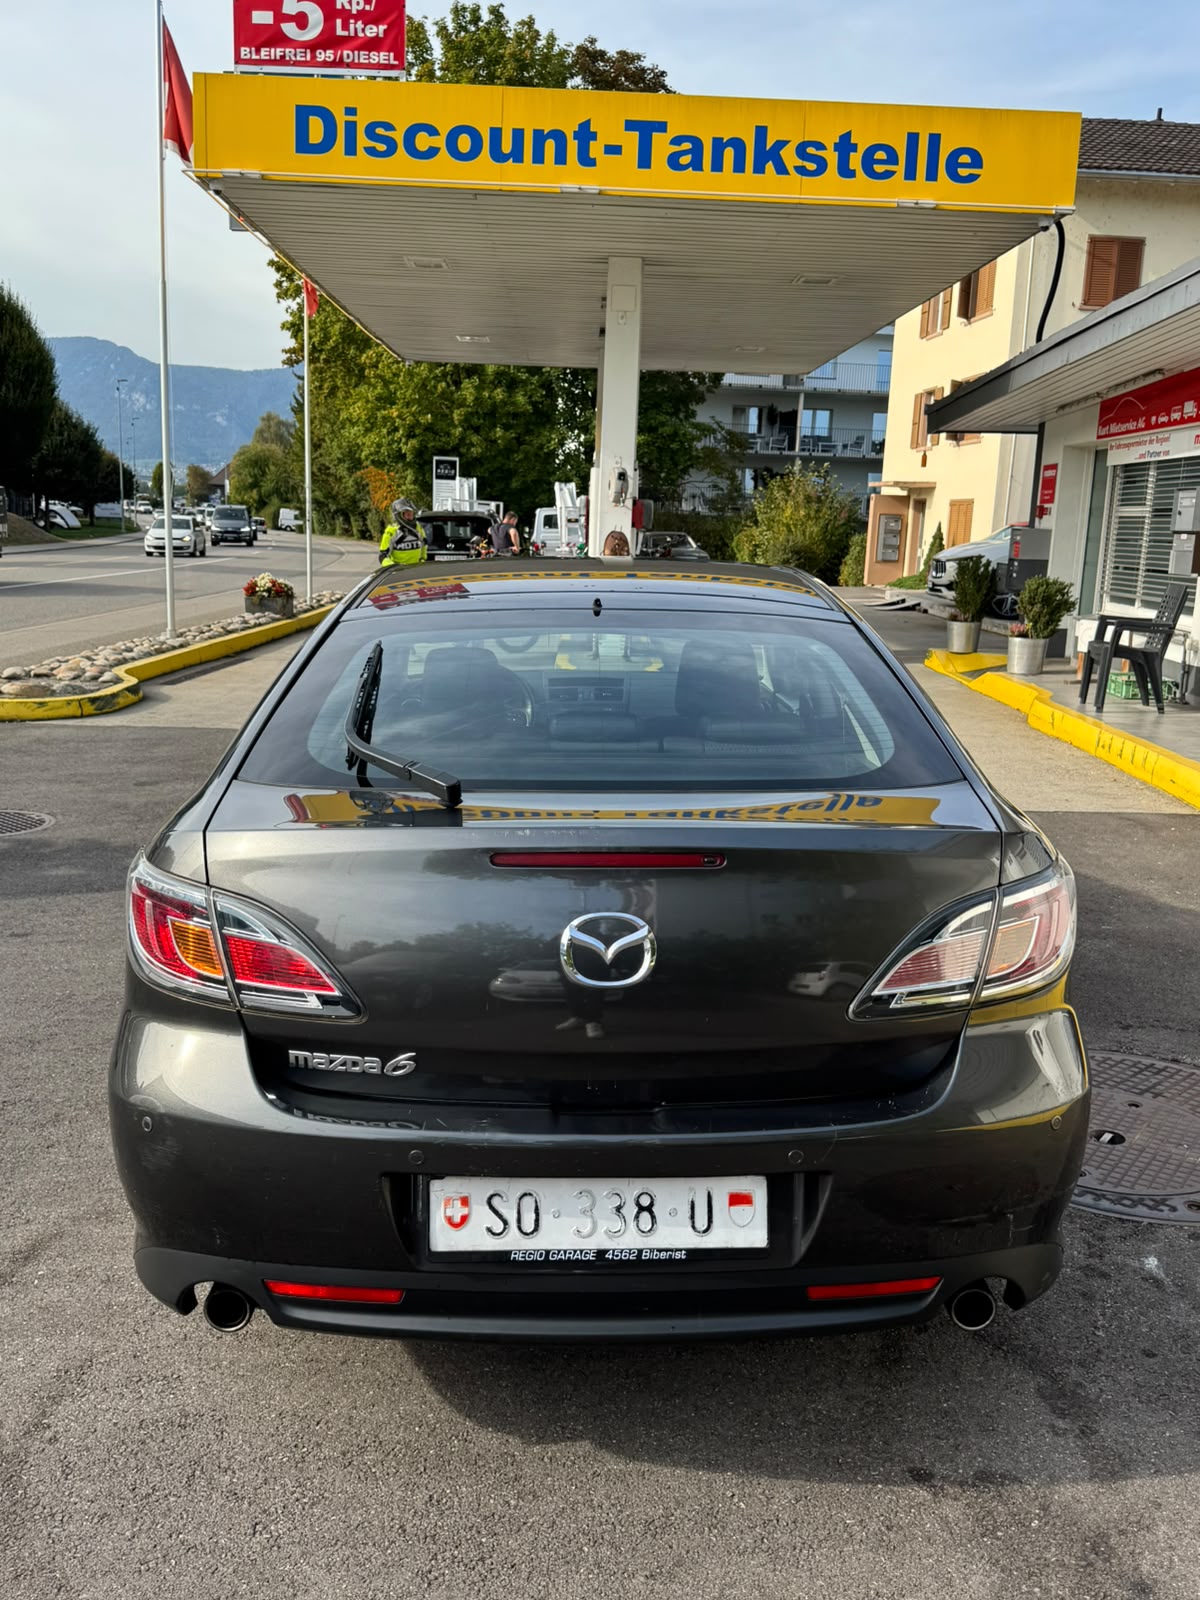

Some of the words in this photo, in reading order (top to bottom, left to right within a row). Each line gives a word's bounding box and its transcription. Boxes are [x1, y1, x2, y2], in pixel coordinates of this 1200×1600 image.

[252, 0, 325, 41] -5
[336, 19, 388, 38] Liter
[240, 47, 311, 62] BLEIFREI
[294, 103, 985, 185] Discount-Tankstelle
[1110, 418, 1137, 434] Mietservice
[485, 1188, 541, 1239] SO
[571, 1187, 657, 1239] 338
[687, 1186, 714, 1237] U
[510, 1249, 546, 1261] REGIO
[548, 1249, 597, 1261] GARAGE
[605, 1249, 638, 1260] 4562
[641, 1248, 687, 1260] Biberist
